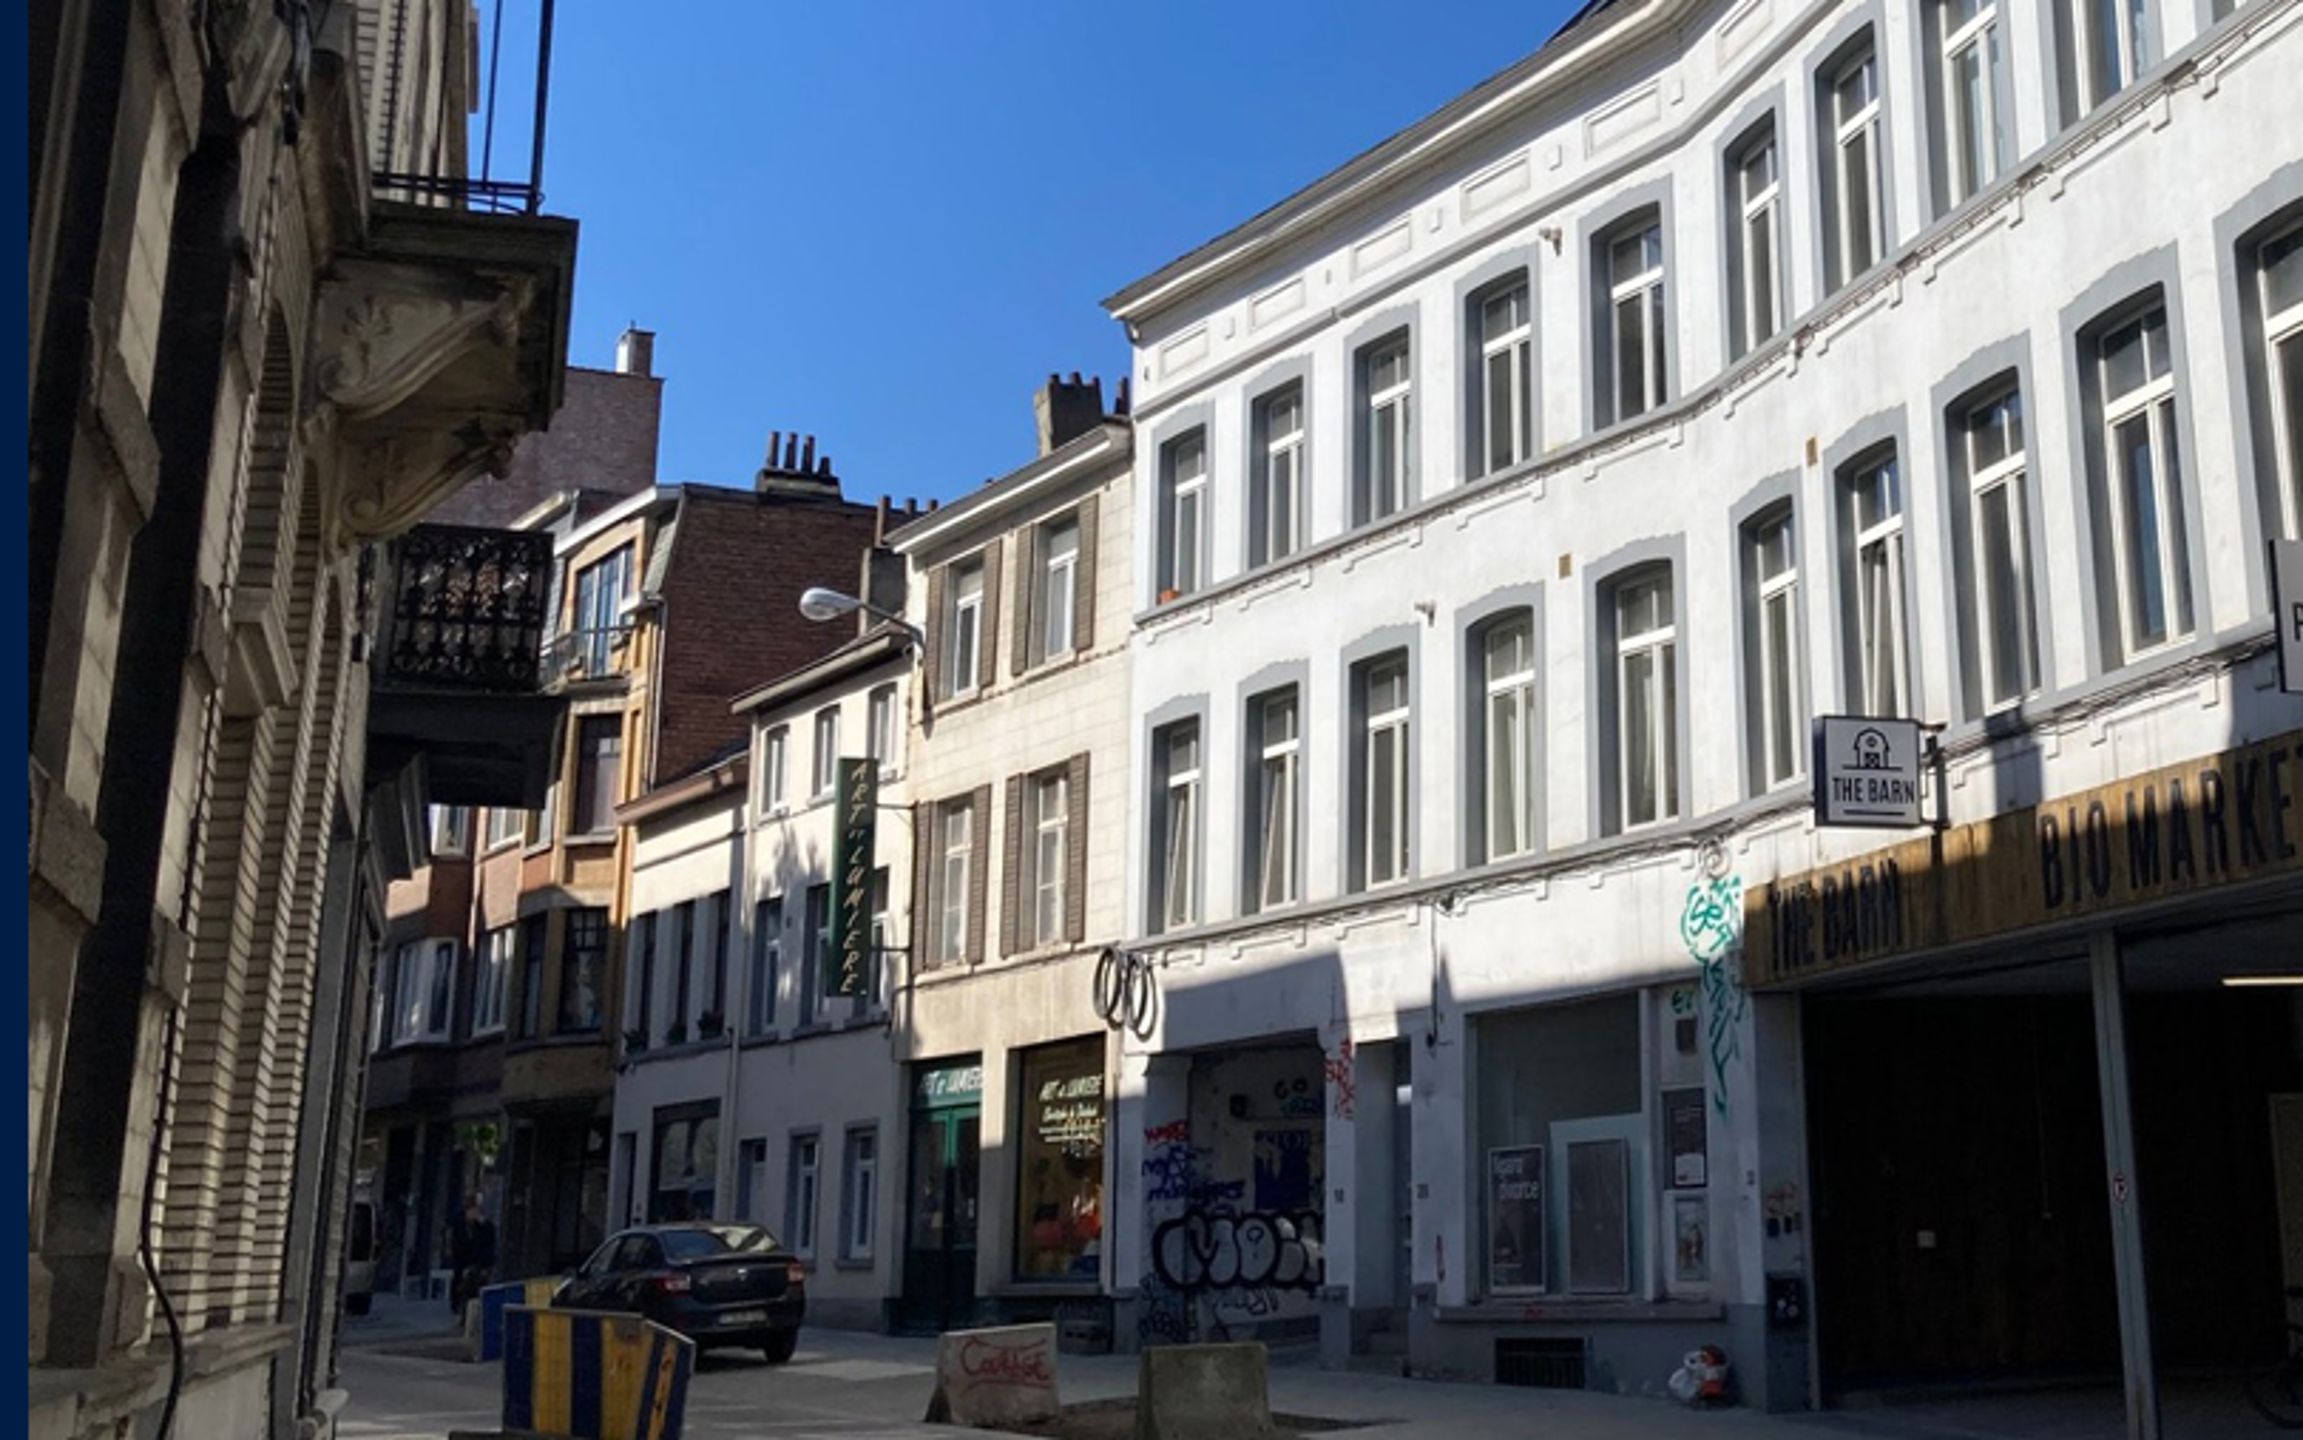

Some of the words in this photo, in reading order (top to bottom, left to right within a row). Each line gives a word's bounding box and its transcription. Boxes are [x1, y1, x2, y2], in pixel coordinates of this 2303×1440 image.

[849, 761, 869, 824] ART
[1832, 777, 1863, 802] THE
[1867, 777, 1915, 804] BARN
[1767, 879, 1816, 972] THE
[1823, 858, 1902, 961] BARN
[2039, 797, 2112, 910] BIO
[2125, 743, 2303, 891] MARKE
